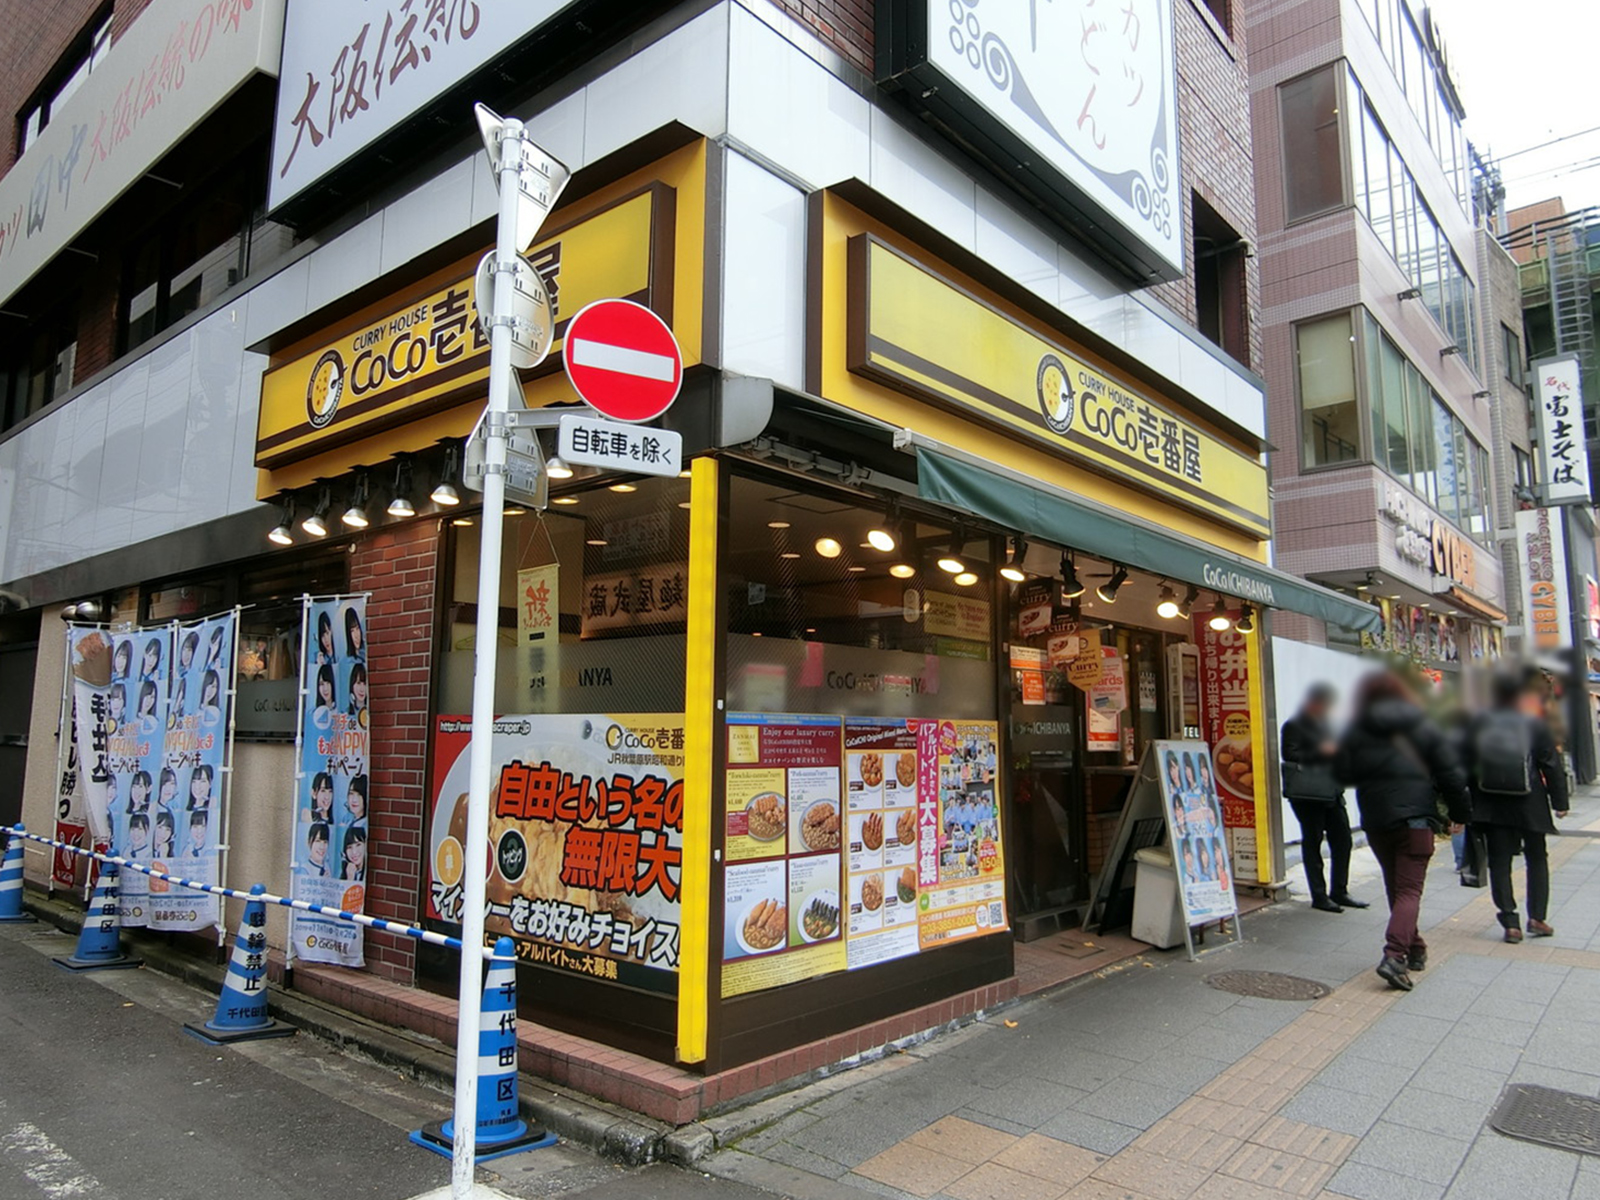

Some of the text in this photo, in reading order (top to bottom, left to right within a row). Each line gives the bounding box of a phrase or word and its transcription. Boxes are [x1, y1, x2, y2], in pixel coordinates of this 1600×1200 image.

[352, 304, 429, 352] CURRY HOUSE
[1078, 371, 1107, 397] CURRY
[1108, 386, 1136, 413] HOUSE
[572, 425, 672, 465] 自転車を除く
[1080, 391, 1202, 483] CoCo壱番屋
[1546, 395, 1583, 486] 富士そば
[1527, 543, 1541, 580] SLOT
[1537, 508, 1554, 581] PACHINKO
[1203, 563, 1275, 604] CoCoICHIBANYA
[1048, 621, 1078, 635] curry
[763, 727, 782, 738] Enjoy
[796, 728, 818, 738] luxury
[818, 730, 837, 739] curry.
[607, 752, 685, 767] JR秋葉原駅昭和通り
[919, 796, 937, 885] 大募集
[101, 870, 119, 933] 千代田区
[244, 911, 266, 991] 駐輪禁止
[497, 980, 516, 1102] 千代田区
